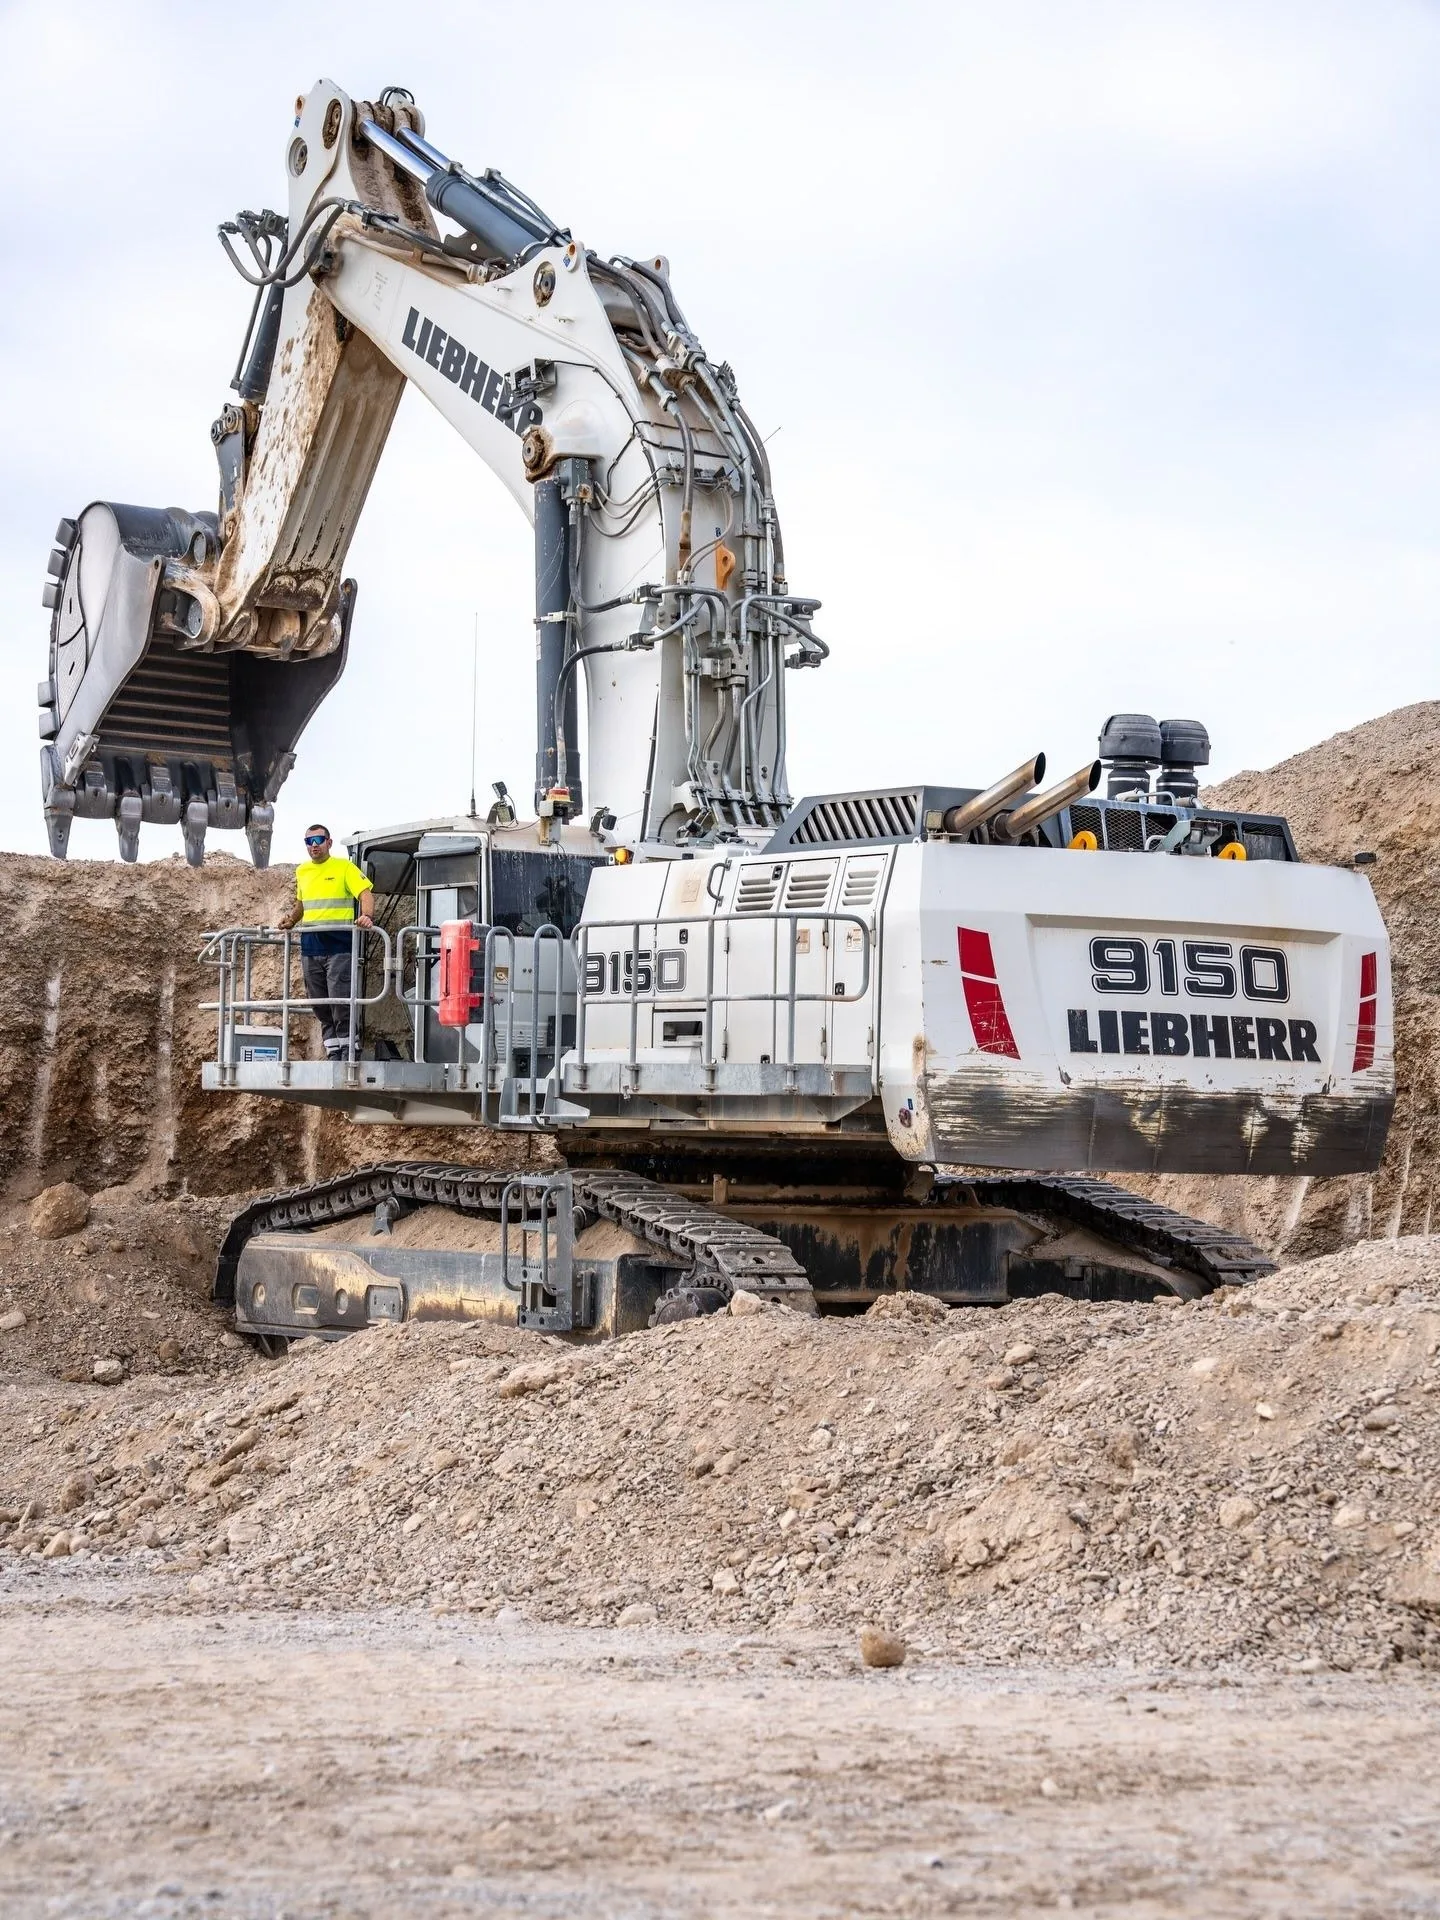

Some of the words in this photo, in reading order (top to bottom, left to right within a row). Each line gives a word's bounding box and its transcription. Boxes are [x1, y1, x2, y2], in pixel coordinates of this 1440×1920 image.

[578, 948, 687, 995] 9150
[1089, 936, 1291, 1003] 9150
[1067, 1008, 1322, 1063] LIEBHERR
